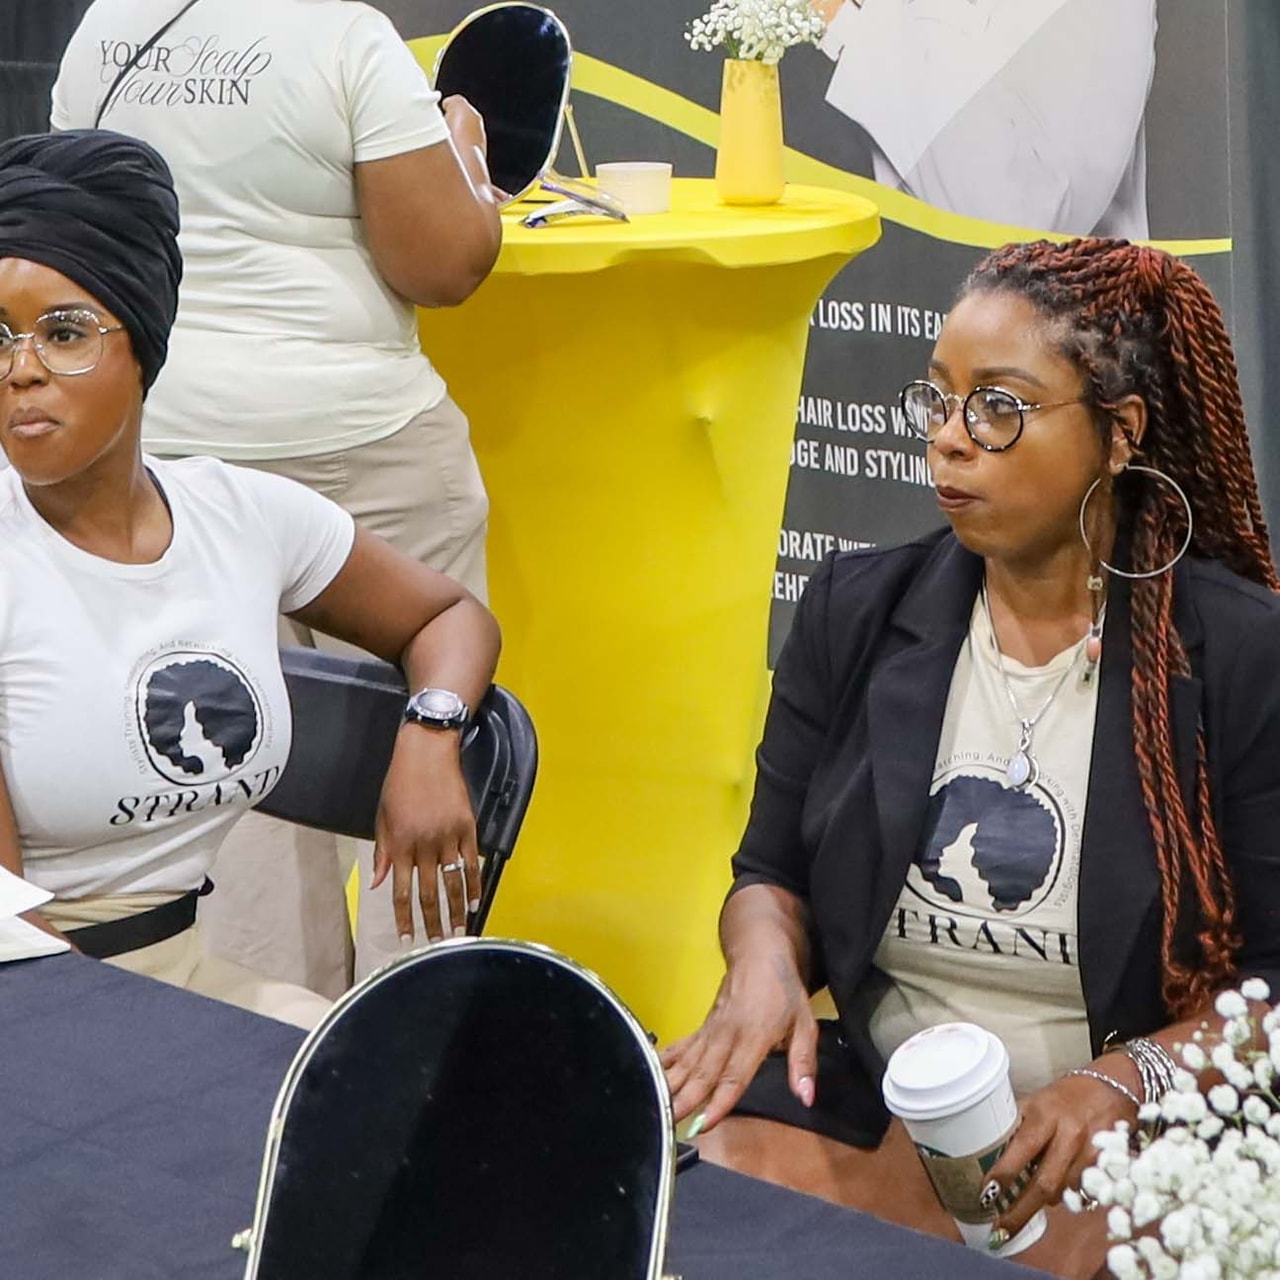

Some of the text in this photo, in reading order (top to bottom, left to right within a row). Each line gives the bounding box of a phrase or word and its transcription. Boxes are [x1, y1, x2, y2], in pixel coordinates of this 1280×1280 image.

[100, 34, 273, 86] YOUR Scalp
[183, 78, 253, 106] SKIN
[818, 299, 865, 332] LOSS
[870, 303, 893, 334] IN
[897, 305, 922, 338] ITS
[924, 310, 947, 341] EA
[797, 395, 834, 429] HAIR
[837, 401, 887, 434] LOSS
[790, 439, 821, 470] GE
[824, 443, 859, 477] AND
[896, 907, 1075, 967] TRAN
